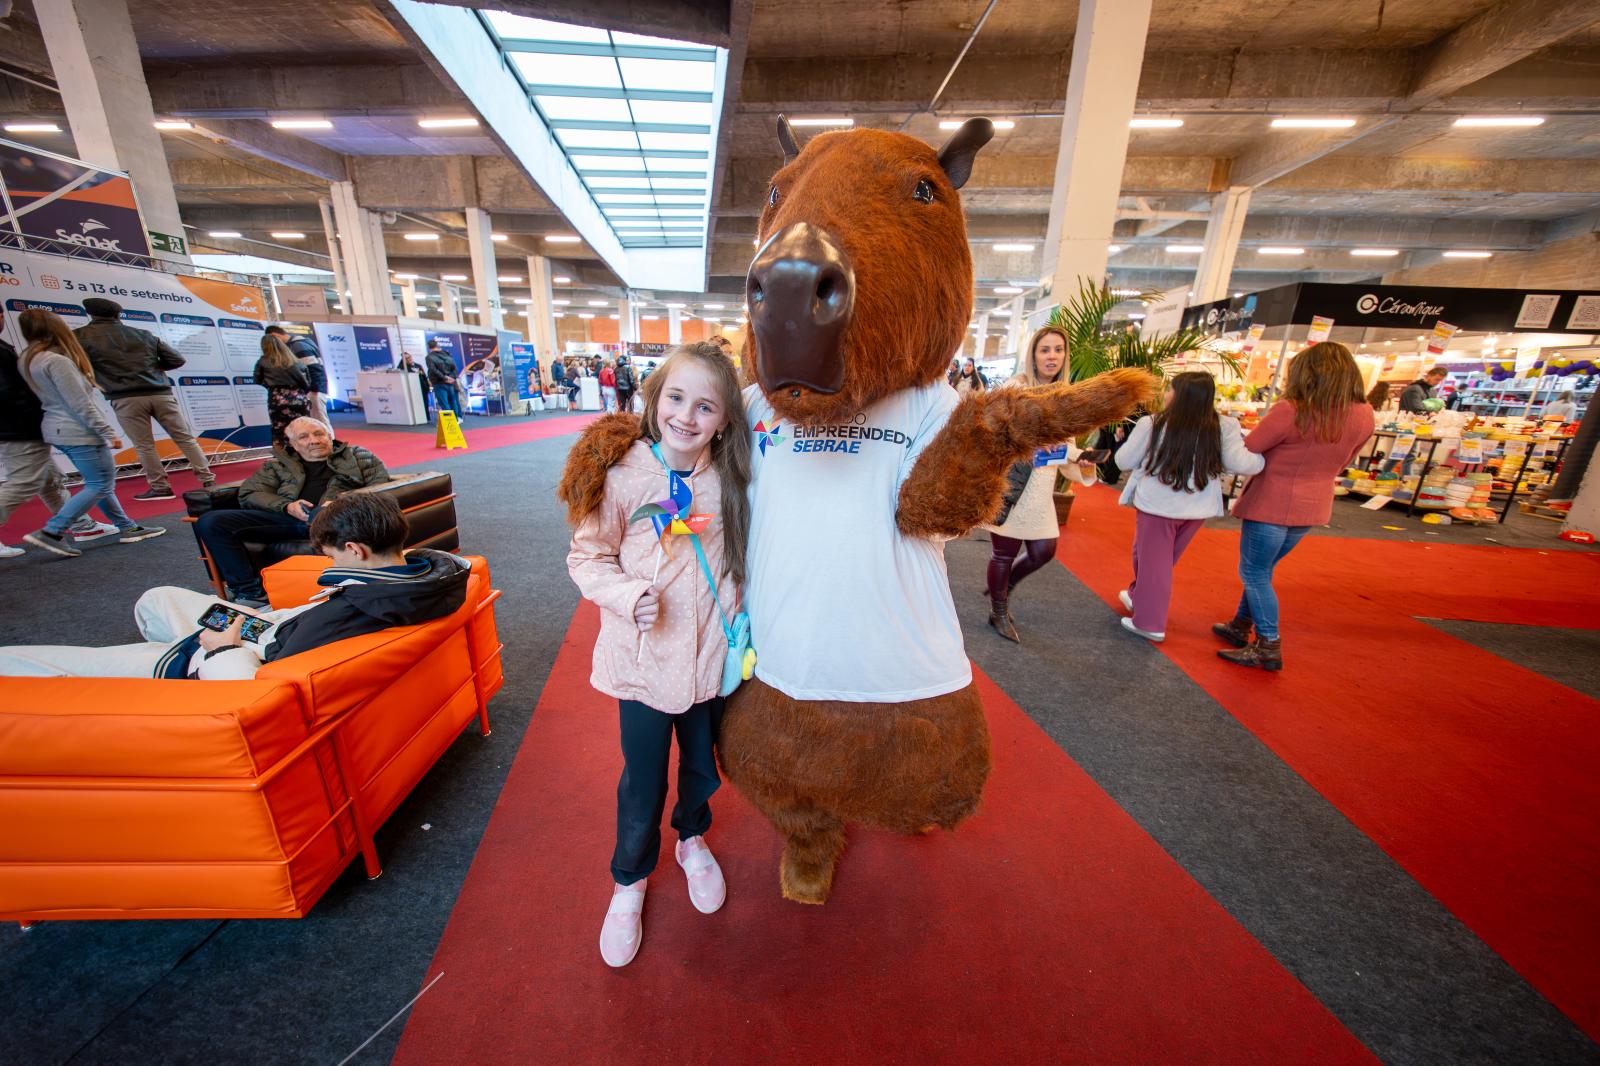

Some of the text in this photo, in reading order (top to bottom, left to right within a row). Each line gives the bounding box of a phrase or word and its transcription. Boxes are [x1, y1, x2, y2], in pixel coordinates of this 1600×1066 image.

[56, 228, 123, 253] Senac
[63, 279, 193, 304] 3 a 13 de setembro
[230, 303, 258, 314] Senac
[792, 438, 862, 454] SEBRAE
